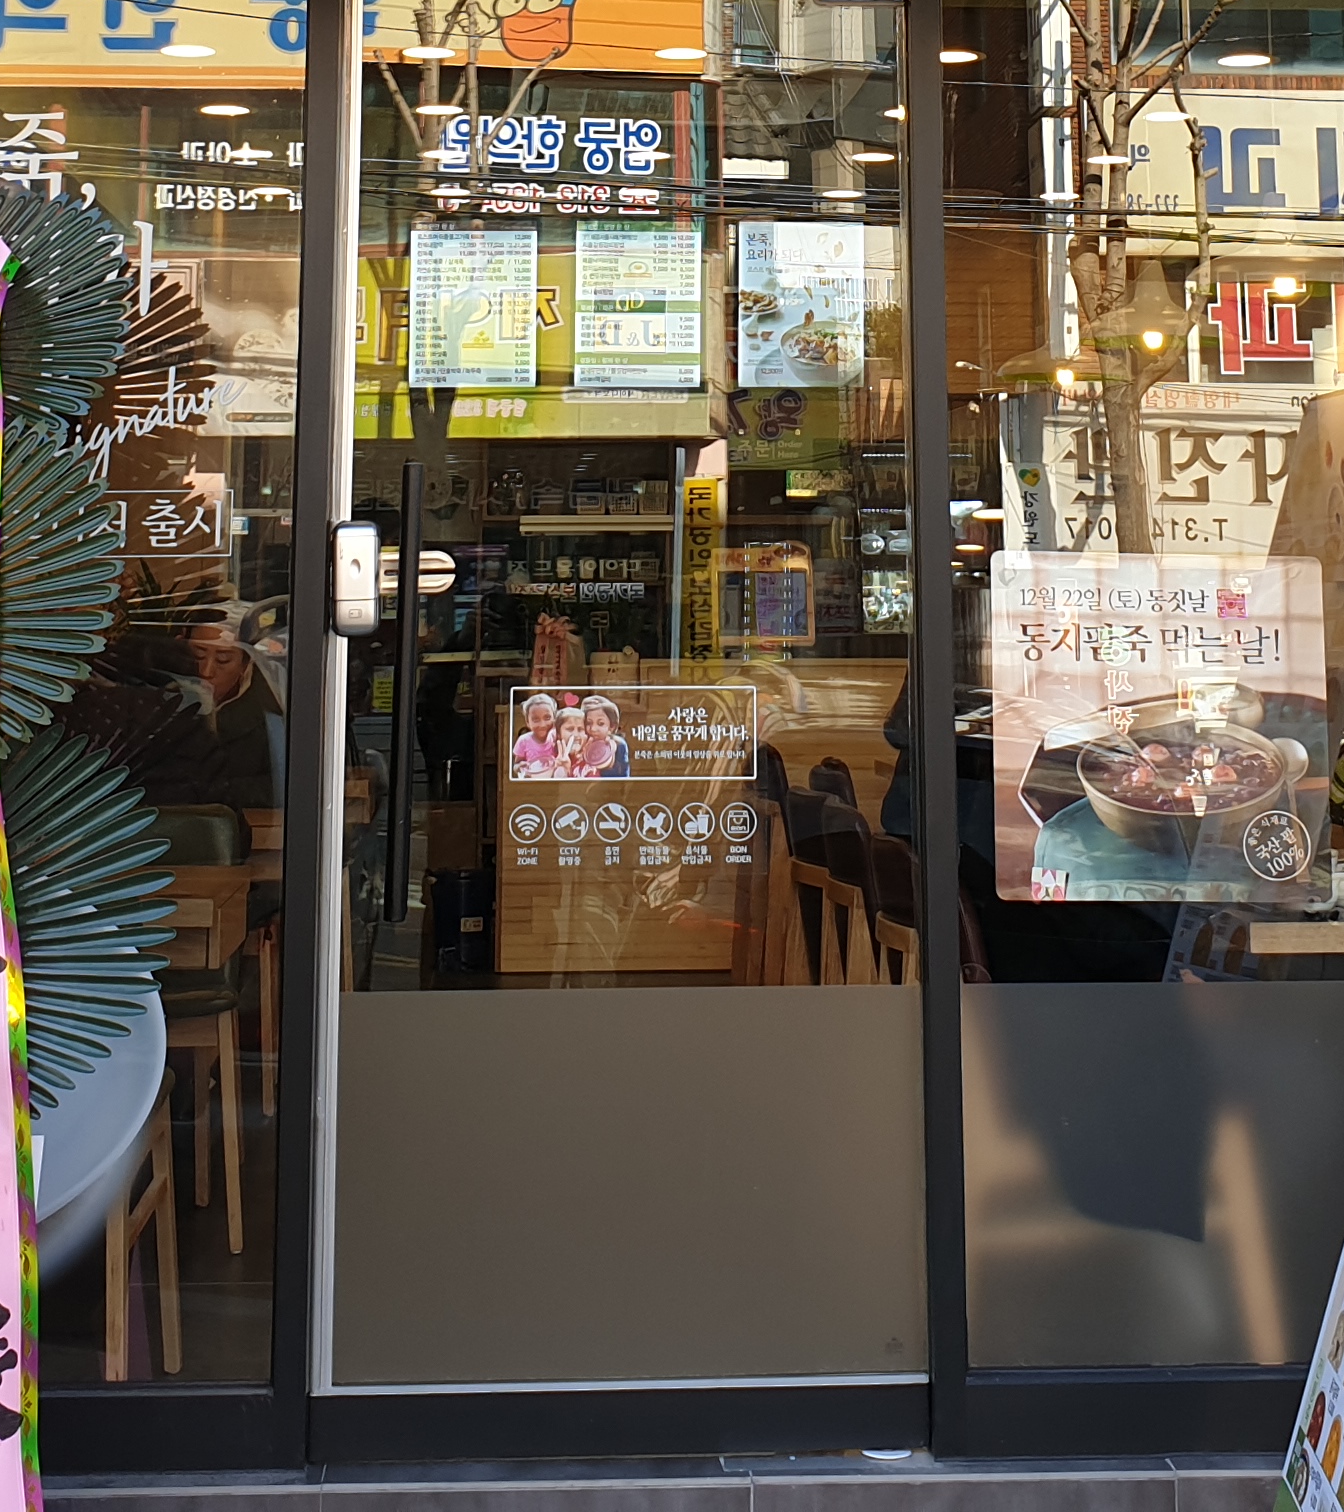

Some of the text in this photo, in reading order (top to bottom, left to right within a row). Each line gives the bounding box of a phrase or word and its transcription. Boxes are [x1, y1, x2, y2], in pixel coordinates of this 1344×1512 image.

[53, 365, 248, 484] ignature
[141, 498, 222, 548] 출시
[1019, 587, 1209, 615] 12월 22일 (토) 동짓날
[667, 707, 709, 724] 사랑은
[632, 725, 669, 742] 내일을
[671, 725, 708, 742] 꿈꾸게
[559, 847, 581, 856] CCTV
[1266, 844, 1305, 877] 100%
